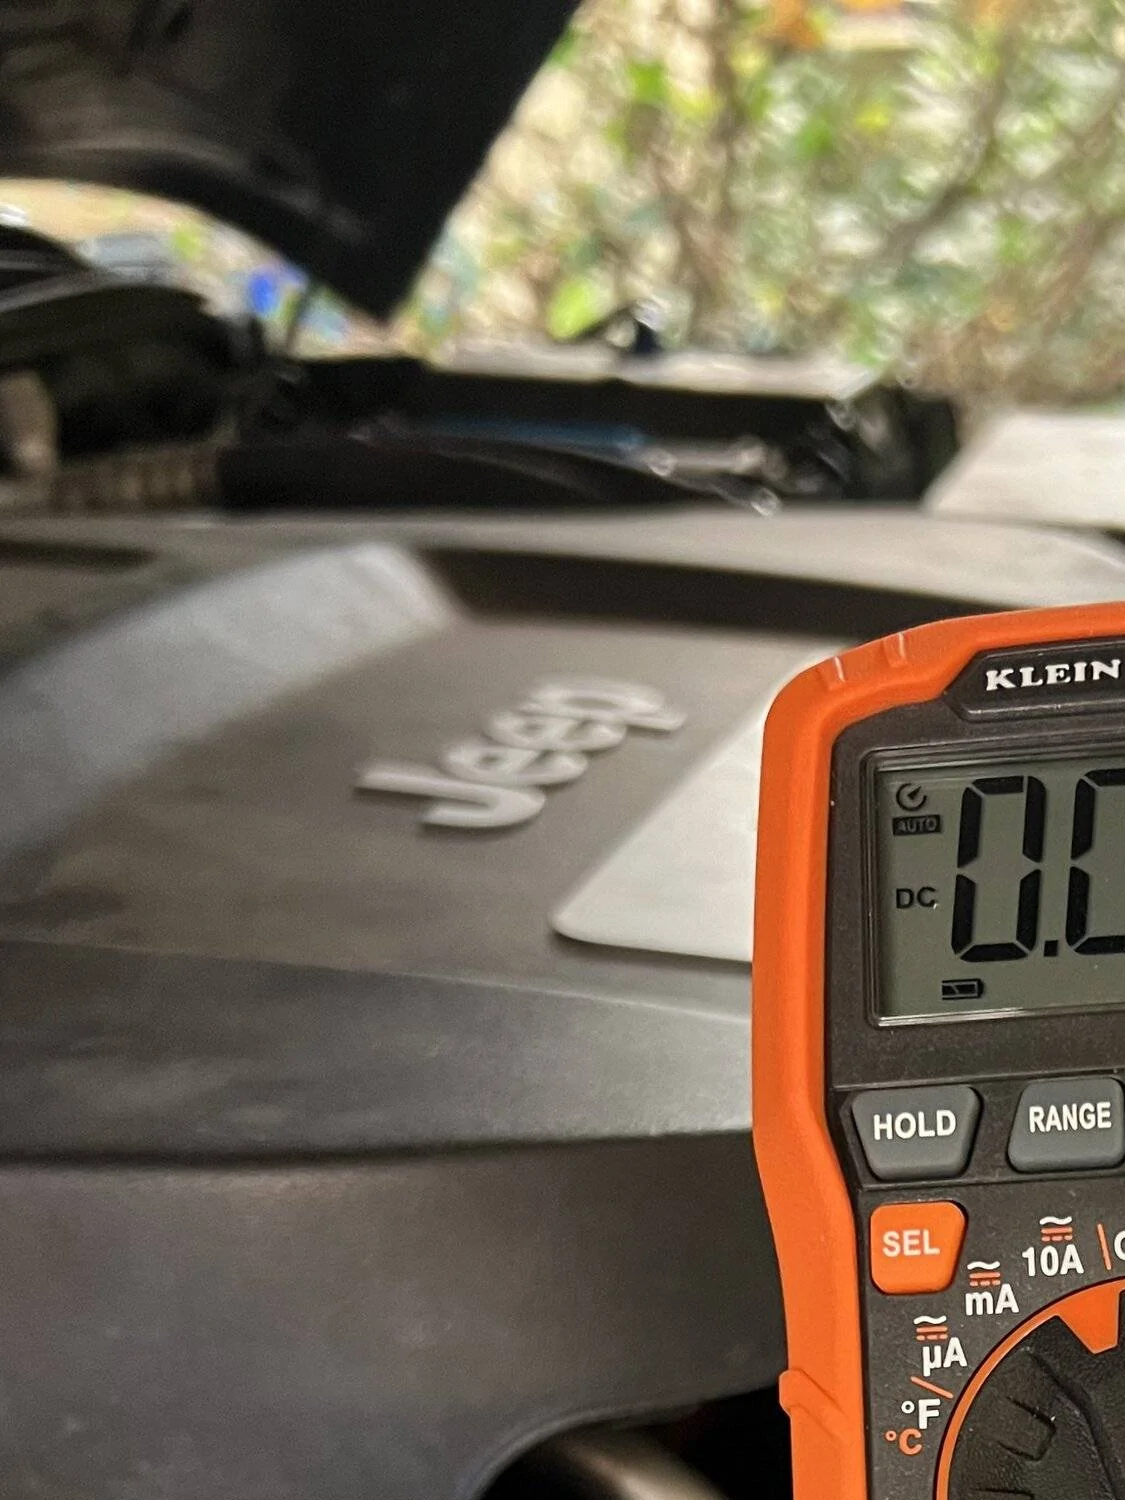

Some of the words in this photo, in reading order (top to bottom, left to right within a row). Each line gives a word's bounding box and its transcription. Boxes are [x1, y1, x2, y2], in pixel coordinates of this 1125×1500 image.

[985, 657, 1121, 691] KLEIN
[353, 675, 690, 830] Jeep
[896, 817, 938, 834] AUTO
[895, 886, 936, 909] DC
[872, 1108, 957, 1140] HOLD
[1027, 1102, 1112, 1134] RANGE
[881, 1231, 941, 1257] SEL
[1021, 1245, 1084, 1277] 10A
[965, 1284, 1020, 1315] mA
[901, 1399, 941, 1430] °F
[885, 1429, 923, 1455] °C
